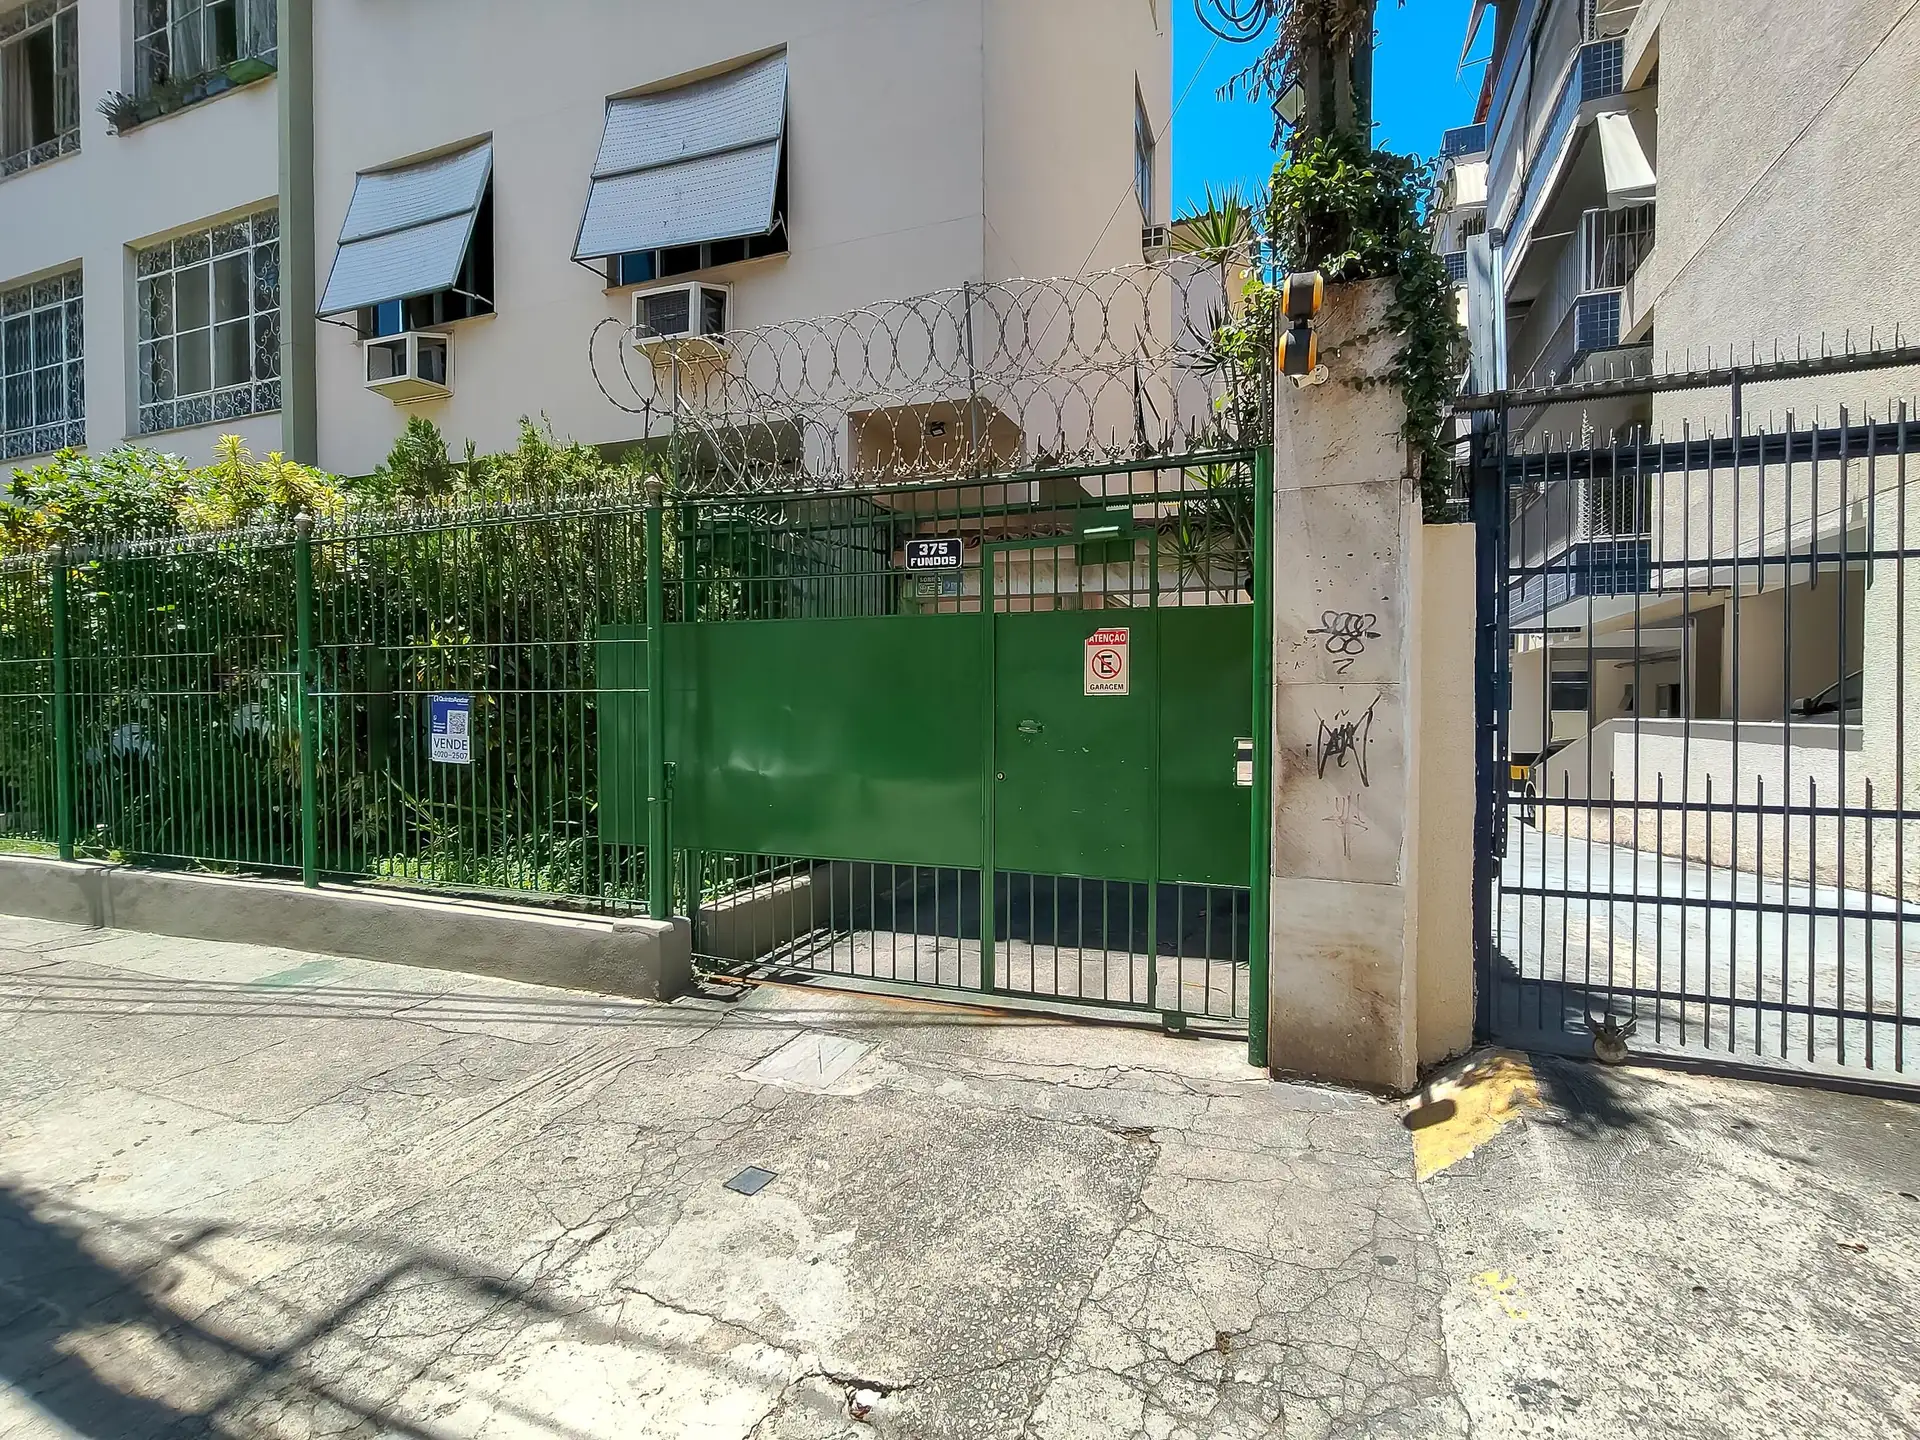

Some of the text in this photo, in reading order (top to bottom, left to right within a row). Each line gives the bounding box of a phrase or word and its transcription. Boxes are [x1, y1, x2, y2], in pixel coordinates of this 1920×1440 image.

[919, 543, 948, 556] 375
[910, 556, 957, 567] FUNDOS
[1089, 631, 1126, 644] ATENÇÃO
[433, 738, 468, 751] VENDE
